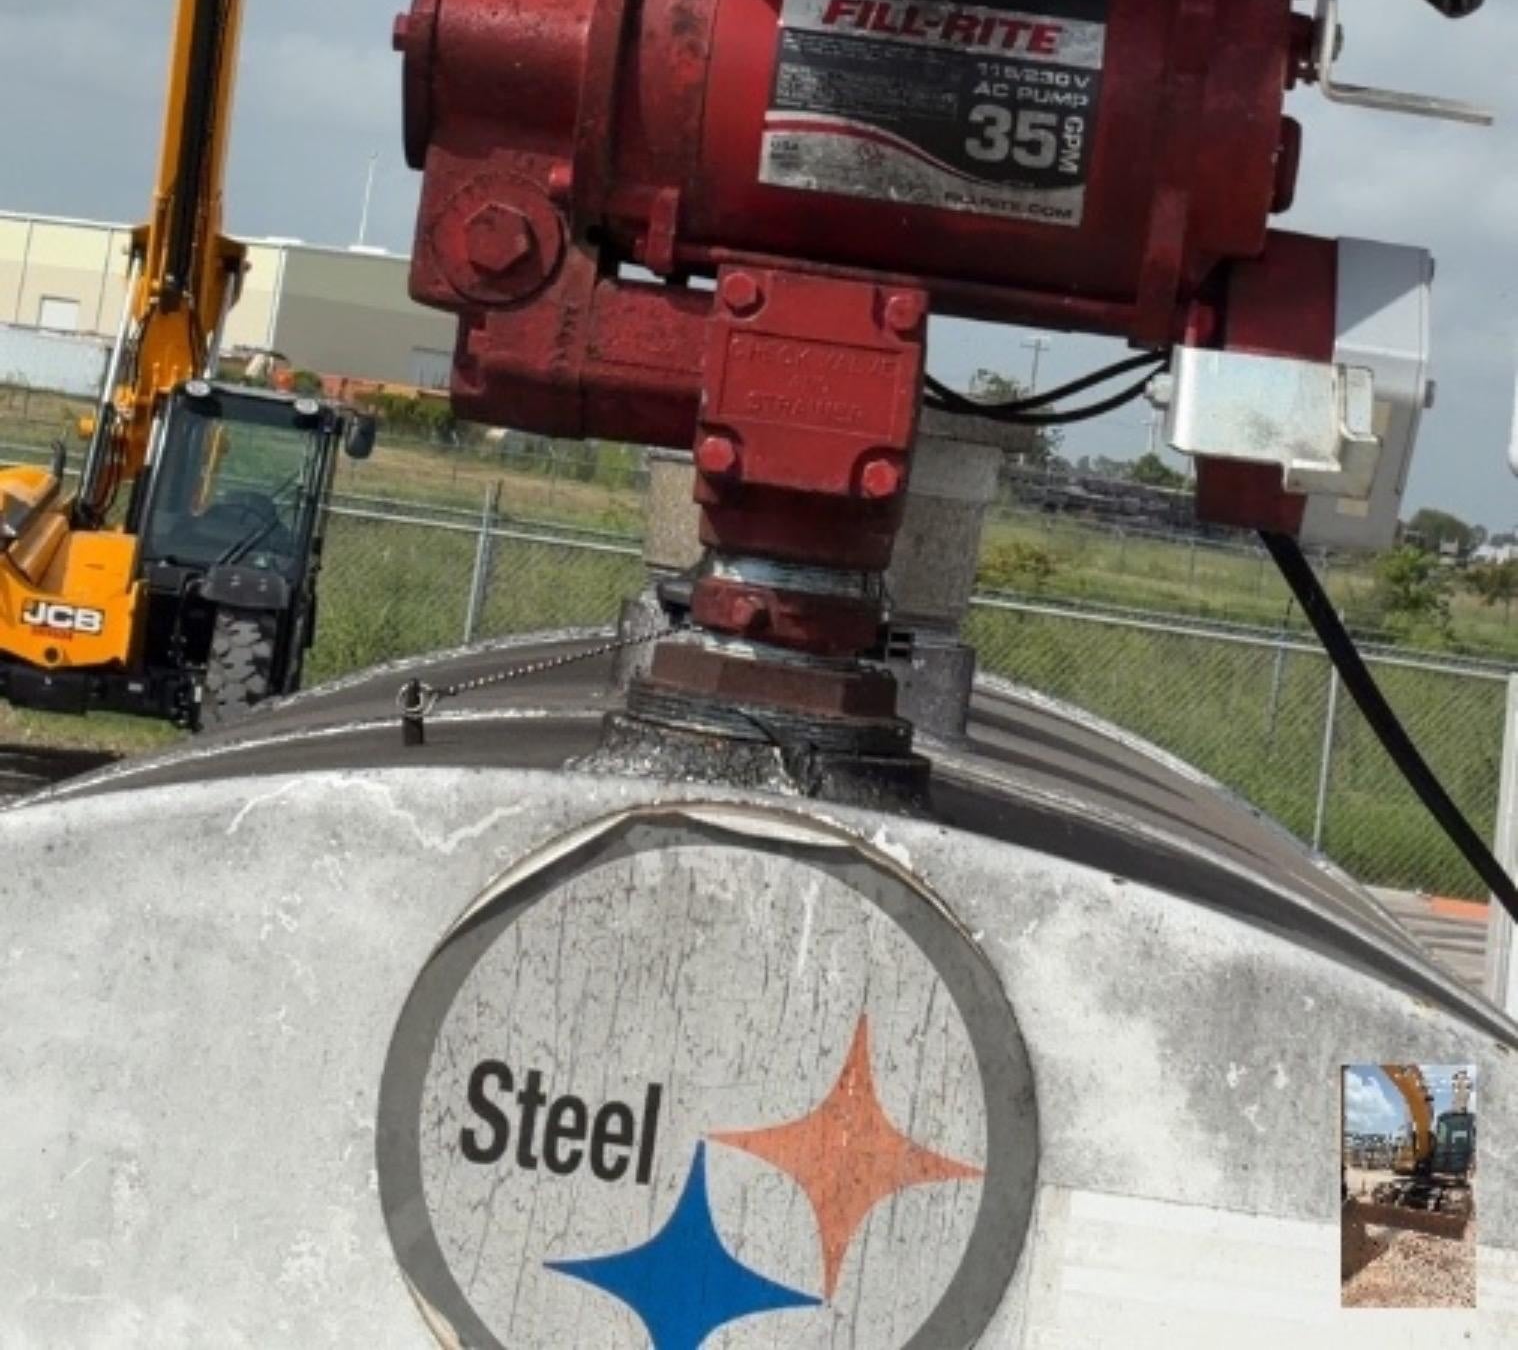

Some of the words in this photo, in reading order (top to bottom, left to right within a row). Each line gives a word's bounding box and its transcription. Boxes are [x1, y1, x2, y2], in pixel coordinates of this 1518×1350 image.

[972, 79, 1010, 98] AC
[1016, 86, 1089, 109] PUMP
[964, 103, 1059, 170] 35
[1057, 115, 1085, 175] GPM
[22, 600, 103, 633] JCB
[459, 1058, 664, 1186] Steel
